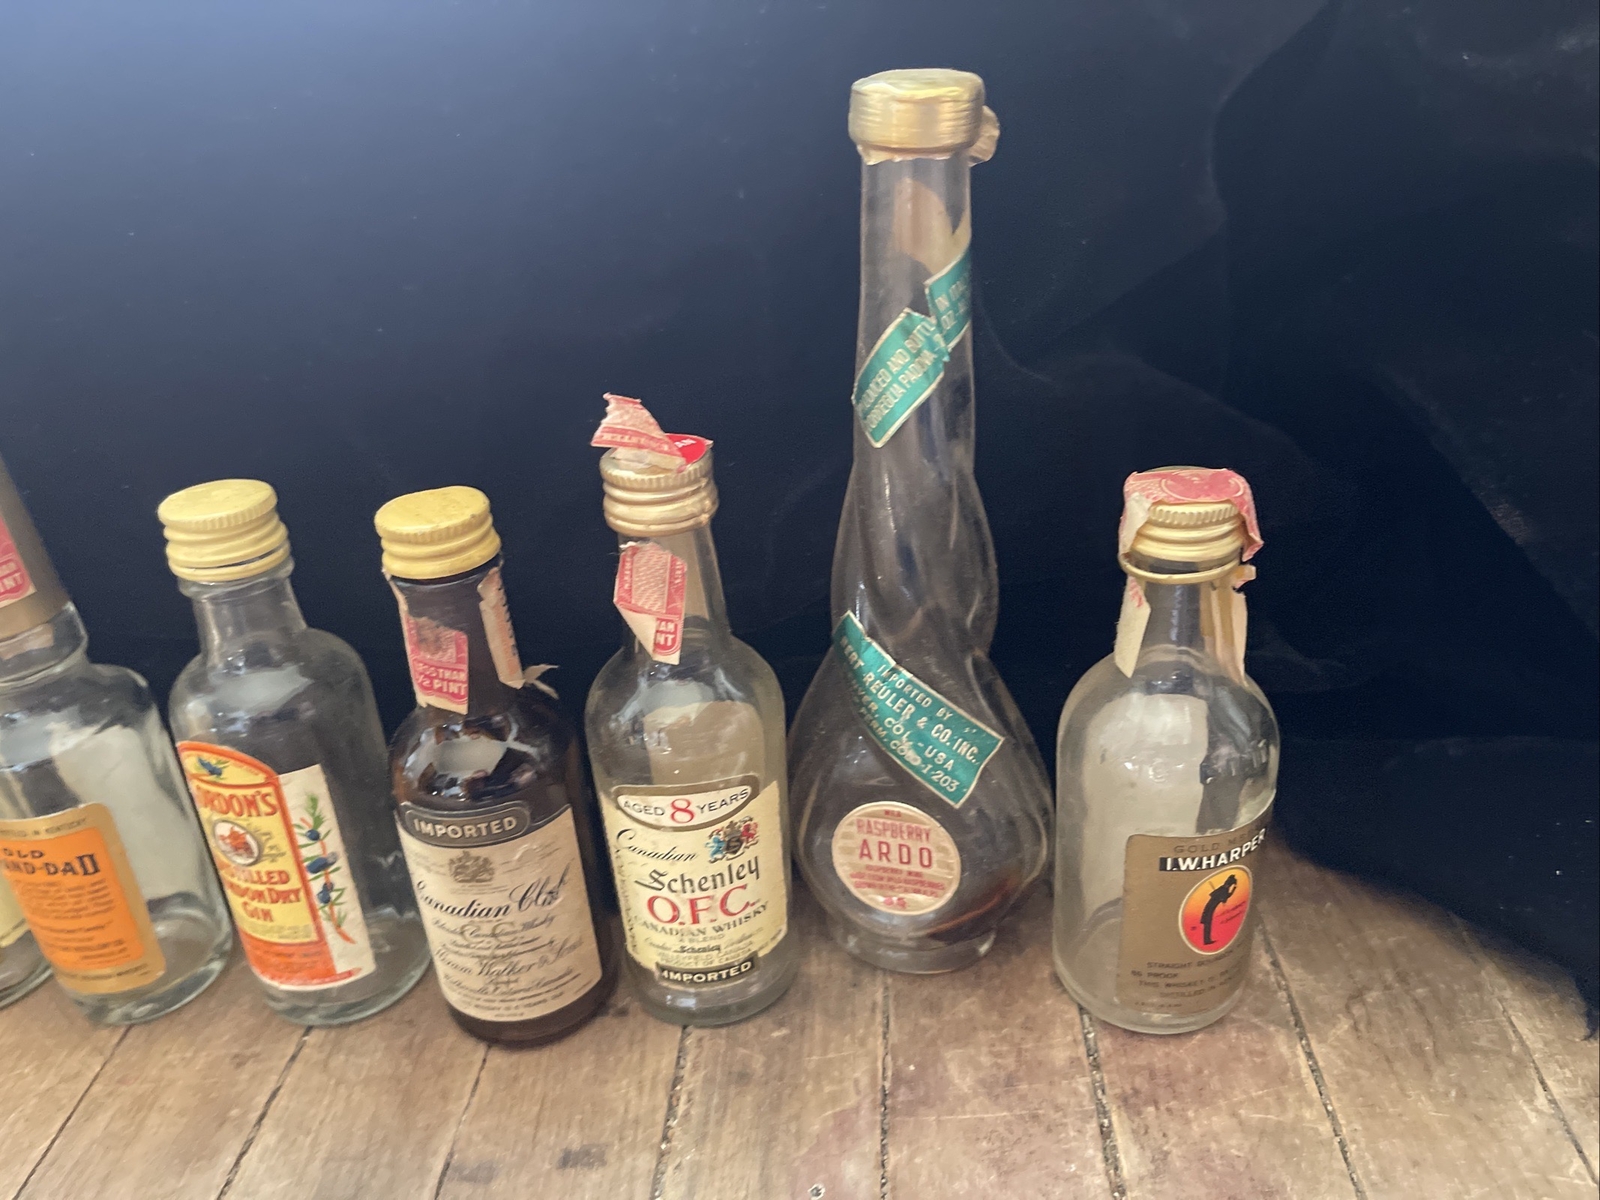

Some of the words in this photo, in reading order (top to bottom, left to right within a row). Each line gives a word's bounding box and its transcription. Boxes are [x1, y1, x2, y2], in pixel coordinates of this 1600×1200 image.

[886, 348, 911, 375] AND
[433, 678, 467, 696] PINT
[863, 671, 917, 720] REULER
[916, 716, 929, 730] &
[876, 663, 933, 708] IMPORTED
[935, 706, 954, 721] BY
[923, 745, 955, 772] USA
[624, 799, 665, 816] AGED
[669, 797, 695, 824] 8
[696, 786, 750, 815] YEARS
[413, 815, 518, 839] IMPORTED
[855, 818, 933, 843] RASPBERRY
[615, 827, 699, 863] Canadian
[858, 838, 933, 869] ARDO
[1173, 842, 1220, 854] GOLD
[634, 854, 761, 895] Schenley
[416, 879, 511, 919] Canadian
[646, 882, 757, 927] O.F.C.
[711, 900, 769, 934] WHISKY
[661, 960, 752, 983] IMPORTED
